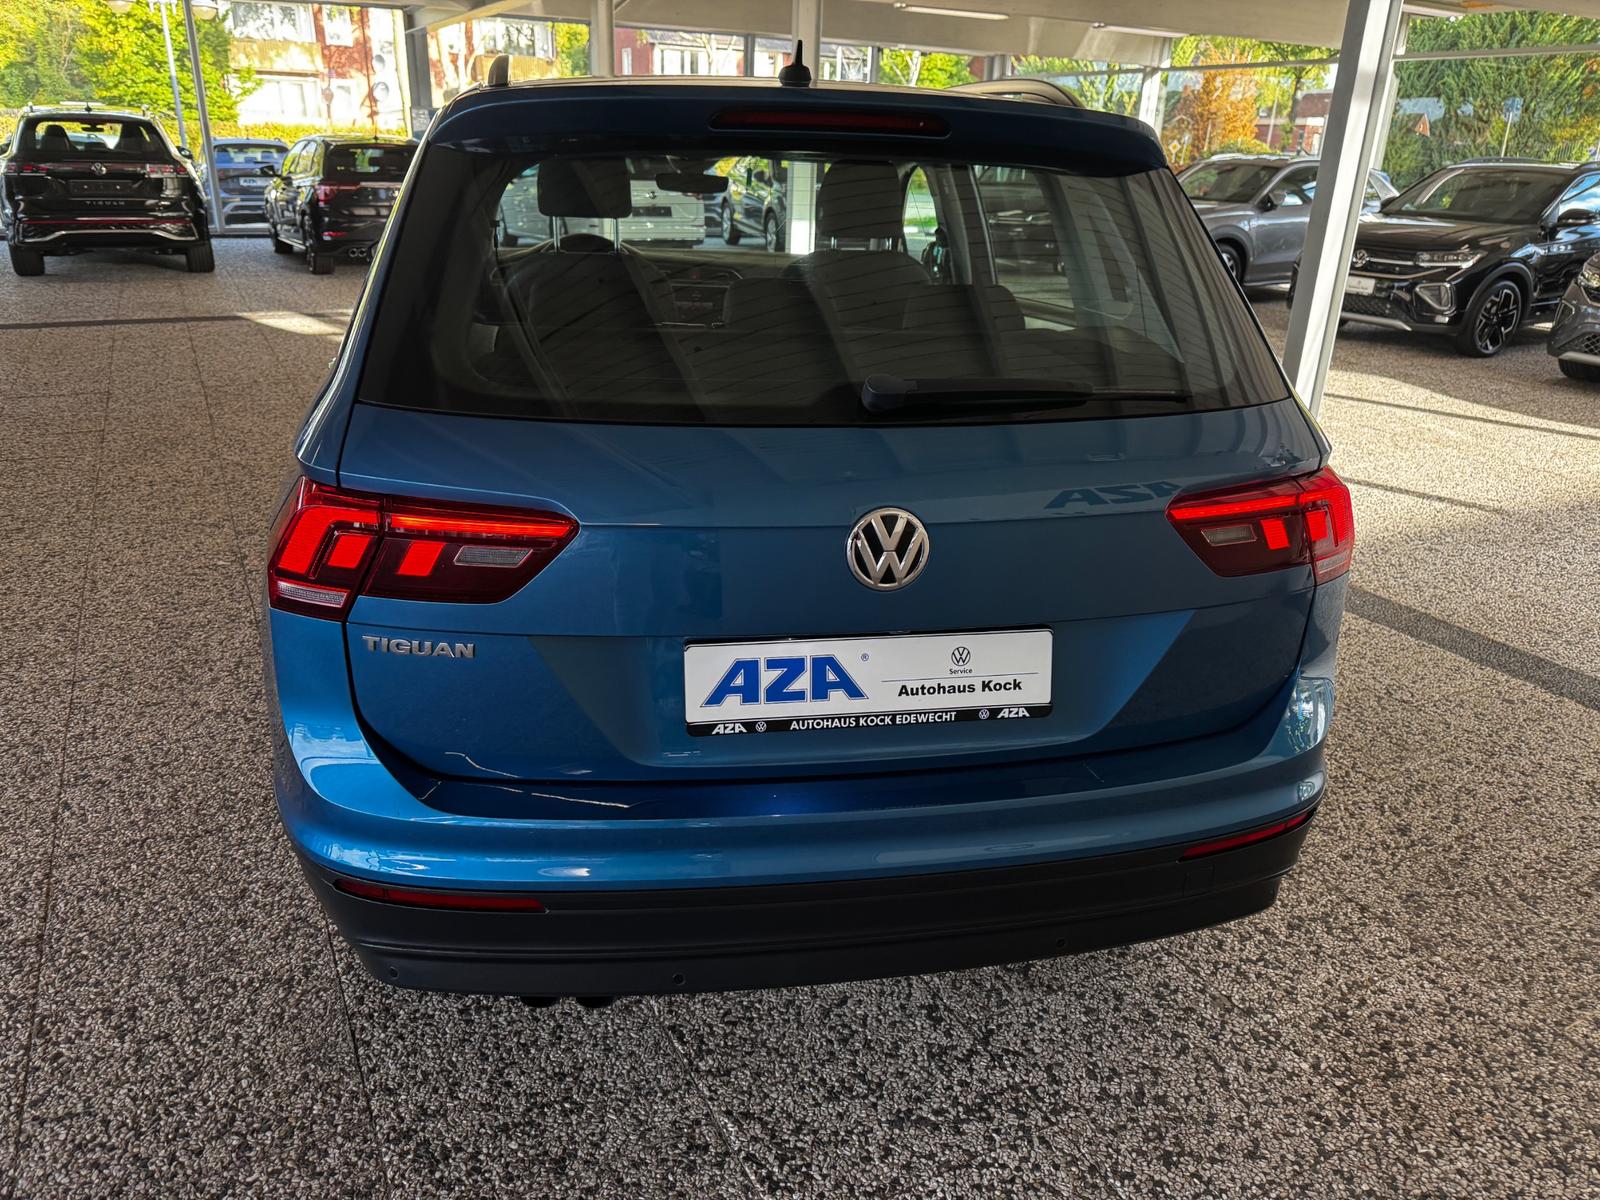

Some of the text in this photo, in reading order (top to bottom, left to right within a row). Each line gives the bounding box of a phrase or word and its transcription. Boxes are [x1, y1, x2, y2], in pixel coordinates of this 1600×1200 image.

[846, 507, 930, 591] VW
[362, 635, 475, 658] TIGUAN
[700, 654, 869, 708] AZA
[949, 667, 973, 675] Service
[897, 679, 1023, 697] Autohaus Kock
[711, 723, 748, 735] AZA
[789, 716, 856, 731] AUTOHAUS
[859, 715, 893, 727] KOCK
[895, 711, 957, 725] EDEWECHT
[996, 707, 1030, 719] AZA
